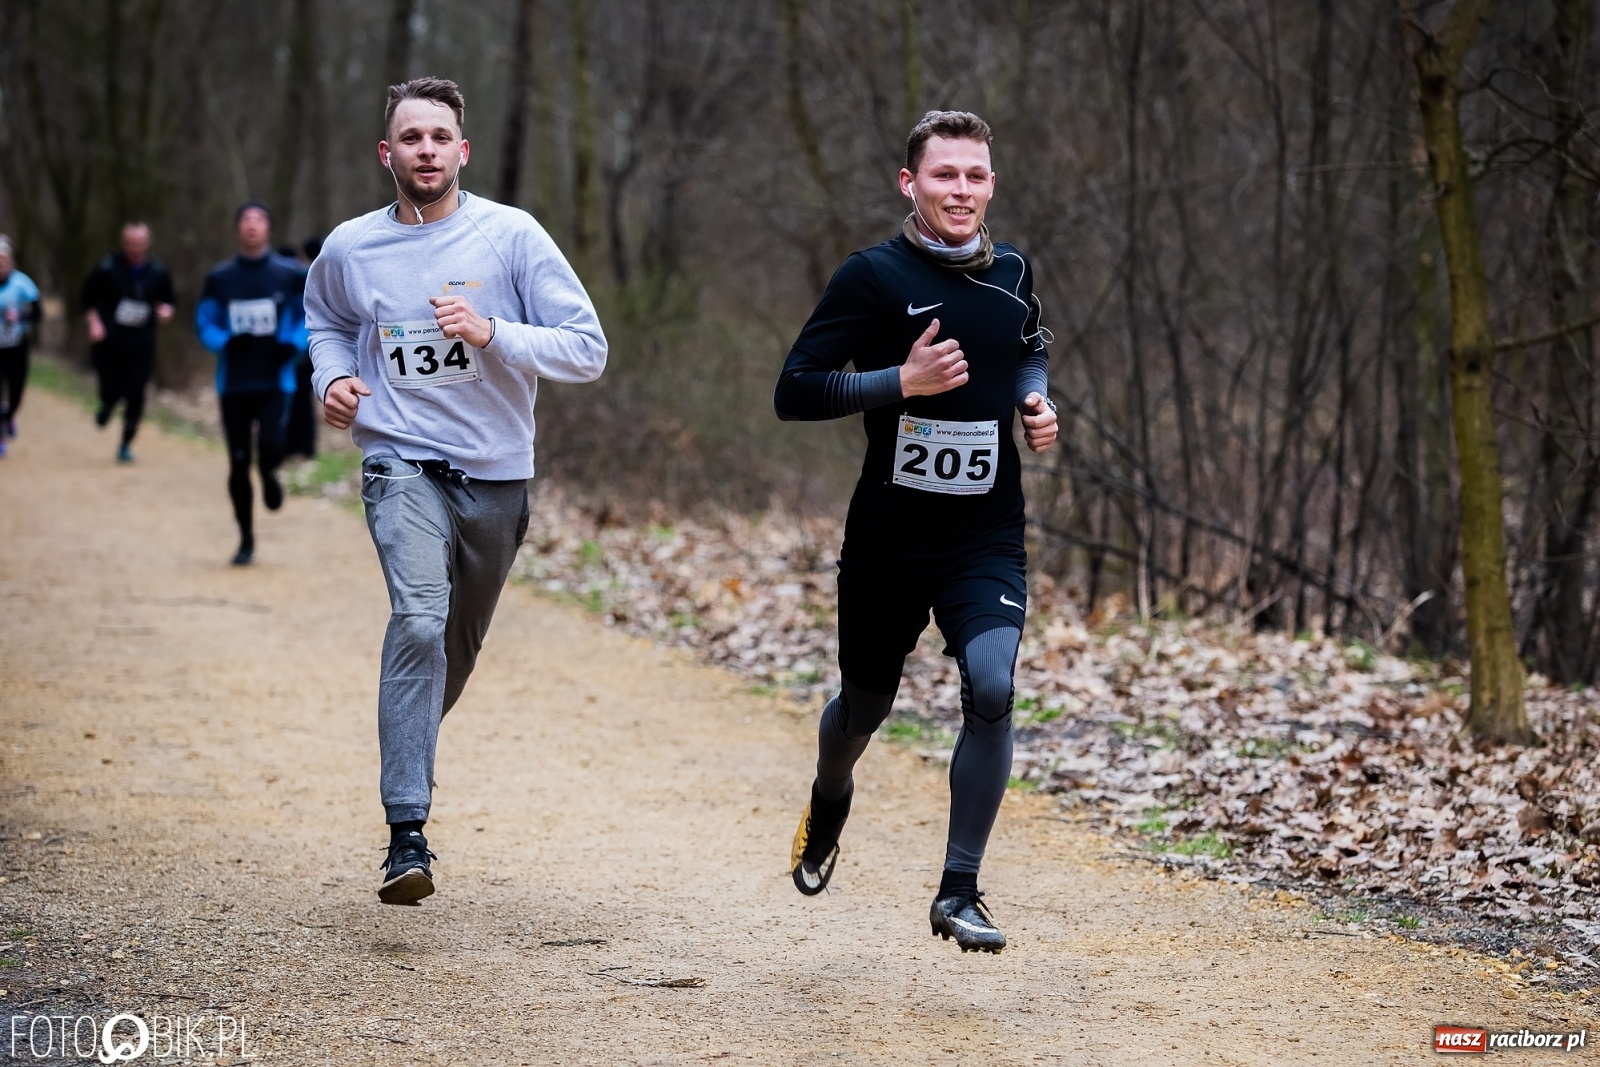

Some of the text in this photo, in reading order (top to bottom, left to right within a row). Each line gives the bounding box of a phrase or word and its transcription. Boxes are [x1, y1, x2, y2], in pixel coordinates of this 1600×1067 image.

[408, 327, 443, 335] www.person
[389, 341, 470, 376] 134
[936, 429, 995, 437] www.personalbest.pl
[900, 443, 992, 482] 205
